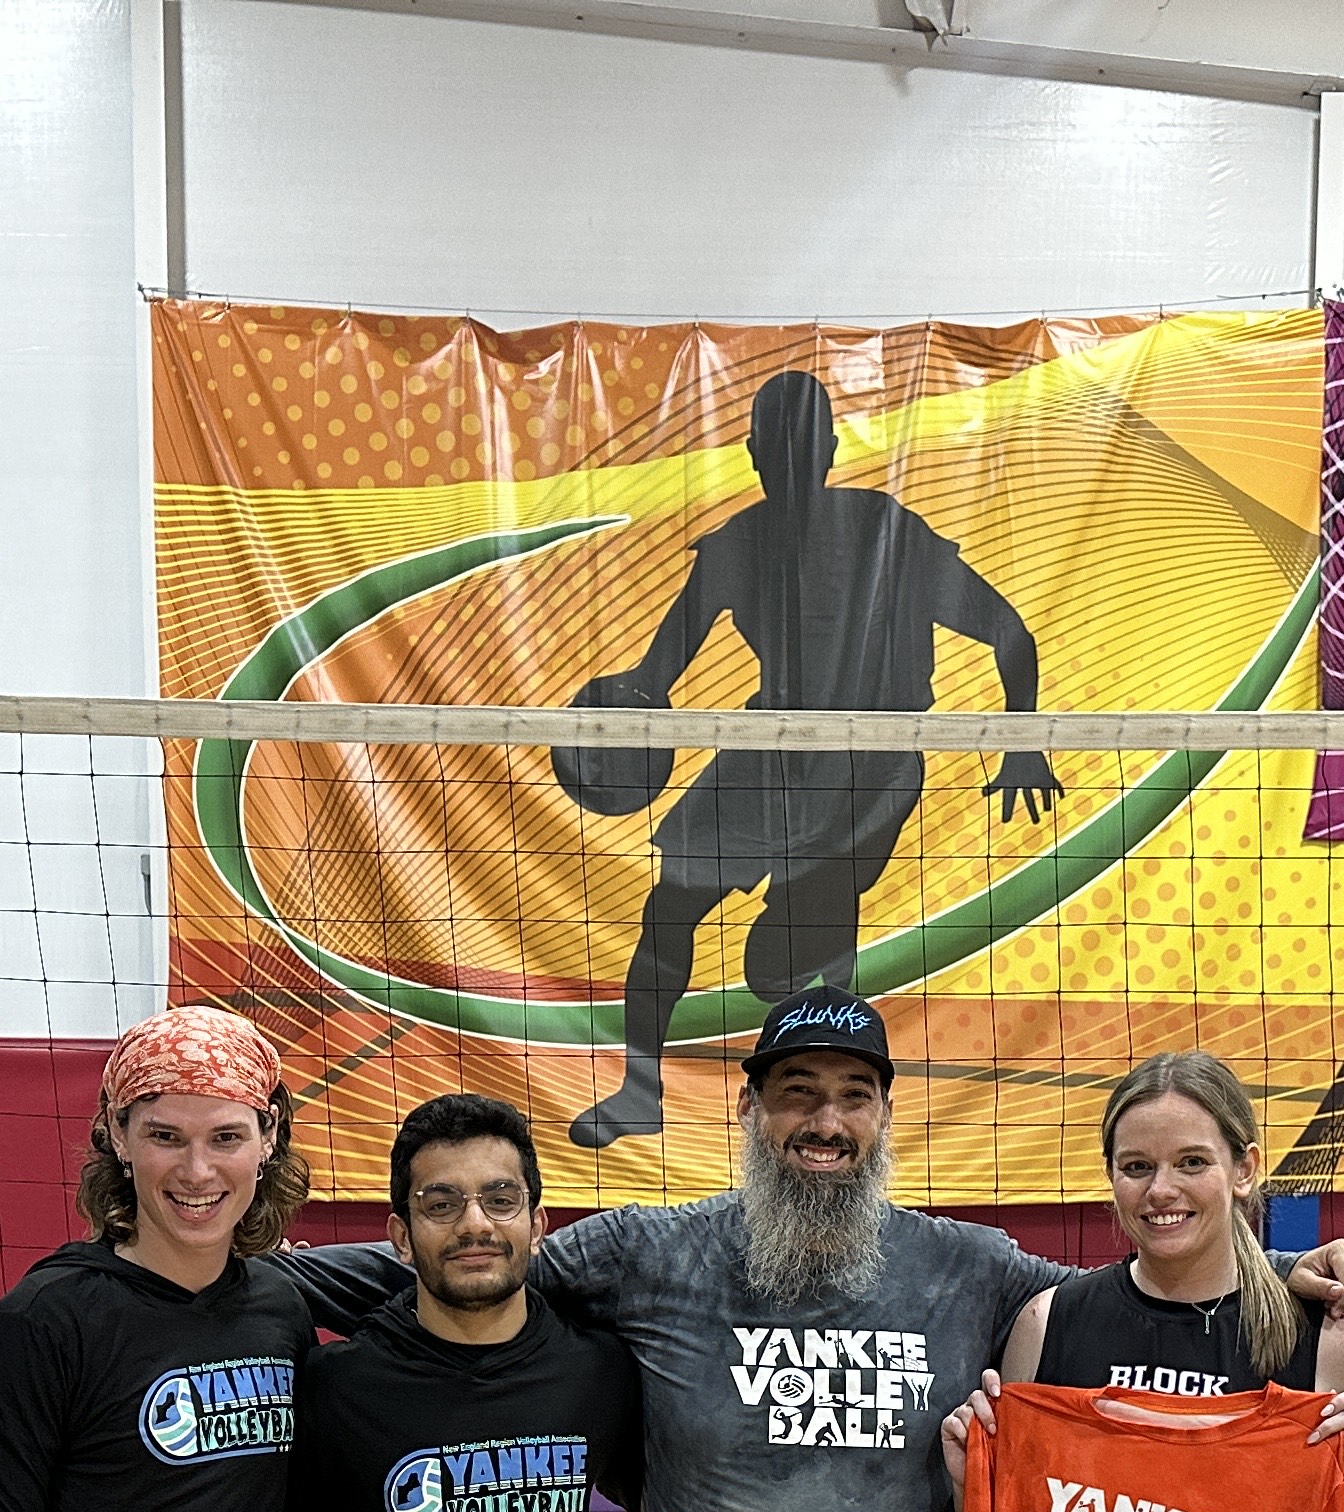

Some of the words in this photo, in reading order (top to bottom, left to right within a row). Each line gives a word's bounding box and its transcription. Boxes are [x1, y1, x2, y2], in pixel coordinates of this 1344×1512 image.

[732, 1327, 929, 1372] YANKEE
[730, 1365, 935, 1411] VOLLEY
[1107, 1365, 1229, 1397] BLOCK
[199, 1407, 294, 1452] VOLLEYBA
[442, 1445, 459, 1453] New
[460, 1441, 489, 1452] England
[490, 1438, 516, 1448] Region
[516, 1436, 549, 1445] Volleyball
[551, 1434, 587, 1443] Association
[768, 1405, 905, 1449] BALL
[444, 1445, 587, 1495] YANKEE
